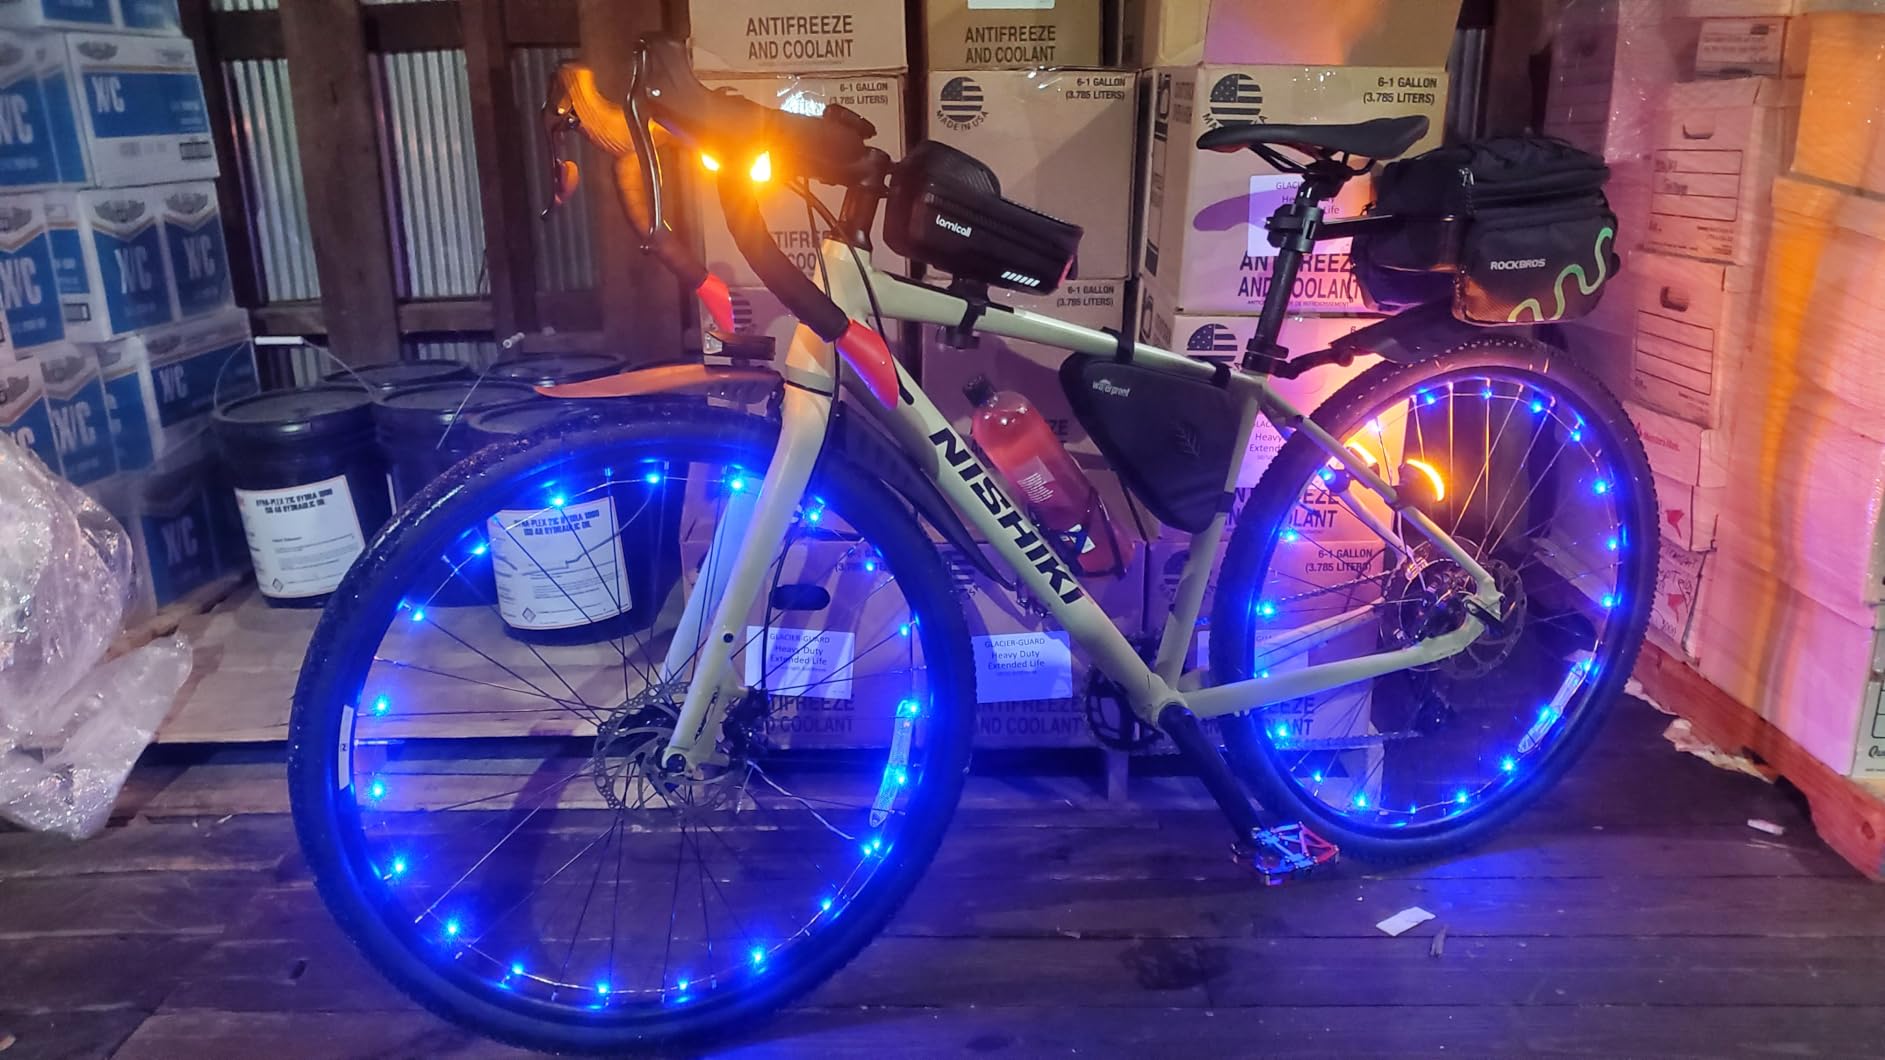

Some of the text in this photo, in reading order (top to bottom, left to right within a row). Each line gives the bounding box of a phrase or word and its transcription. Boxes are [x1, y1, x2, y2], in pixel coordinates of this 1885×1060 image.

[746, 15, 853, 36] ANTIFREEZE
[965, 25, 1056, 43] ANTIFREEZE
[748, 39, 853, 60] AND COOLANT
[966, 46, 1056, 63] AND COOLANT
[840, 82, 888, 92] 6-1 GALLON
[1077, 77, 1126, 87] 6-1 GALLON
[1377, 77, 1438, 88] 6-1 GALLON
[856, 95, 889, 105] LITERS)
[1065, 90, 1126, 101] (3.785 LITERS)
[1363, 92, 1435, 105] (3.785 LITERS)
[936, 110, 990, 132] MADE IN USA
[1490, 258, 1546, 271] ROCKBROS
[1067, 285, 1114, 295] 6-1 GALLON
[1292, 277, 1362, 299] OOLANT
[1083, 297, 1114, 307] LITERS)
[1255, 433, 1282, 443] Heavy
[1249, 443, 1281, 452] Extend
[928, 427, 1085, 605] NISHIKI
[1318, 548, 1373, 558] 6-1 GALLON
[1304, 562, 1372, 573] (3.785 LITERS)
[984, 638, 1046, 648] GLACIER-GUARD
[774, 645, 824, 656] Heavy Duty
[992, 650, 1040, 660] Heavy Duty
[769, 655, 827, 665] Extended Life
[987, 660, 1046, 670] Extended Life
[776, 717, 854, 733] COOLANT
[1006, 717, 1082, 735] COOLANT
